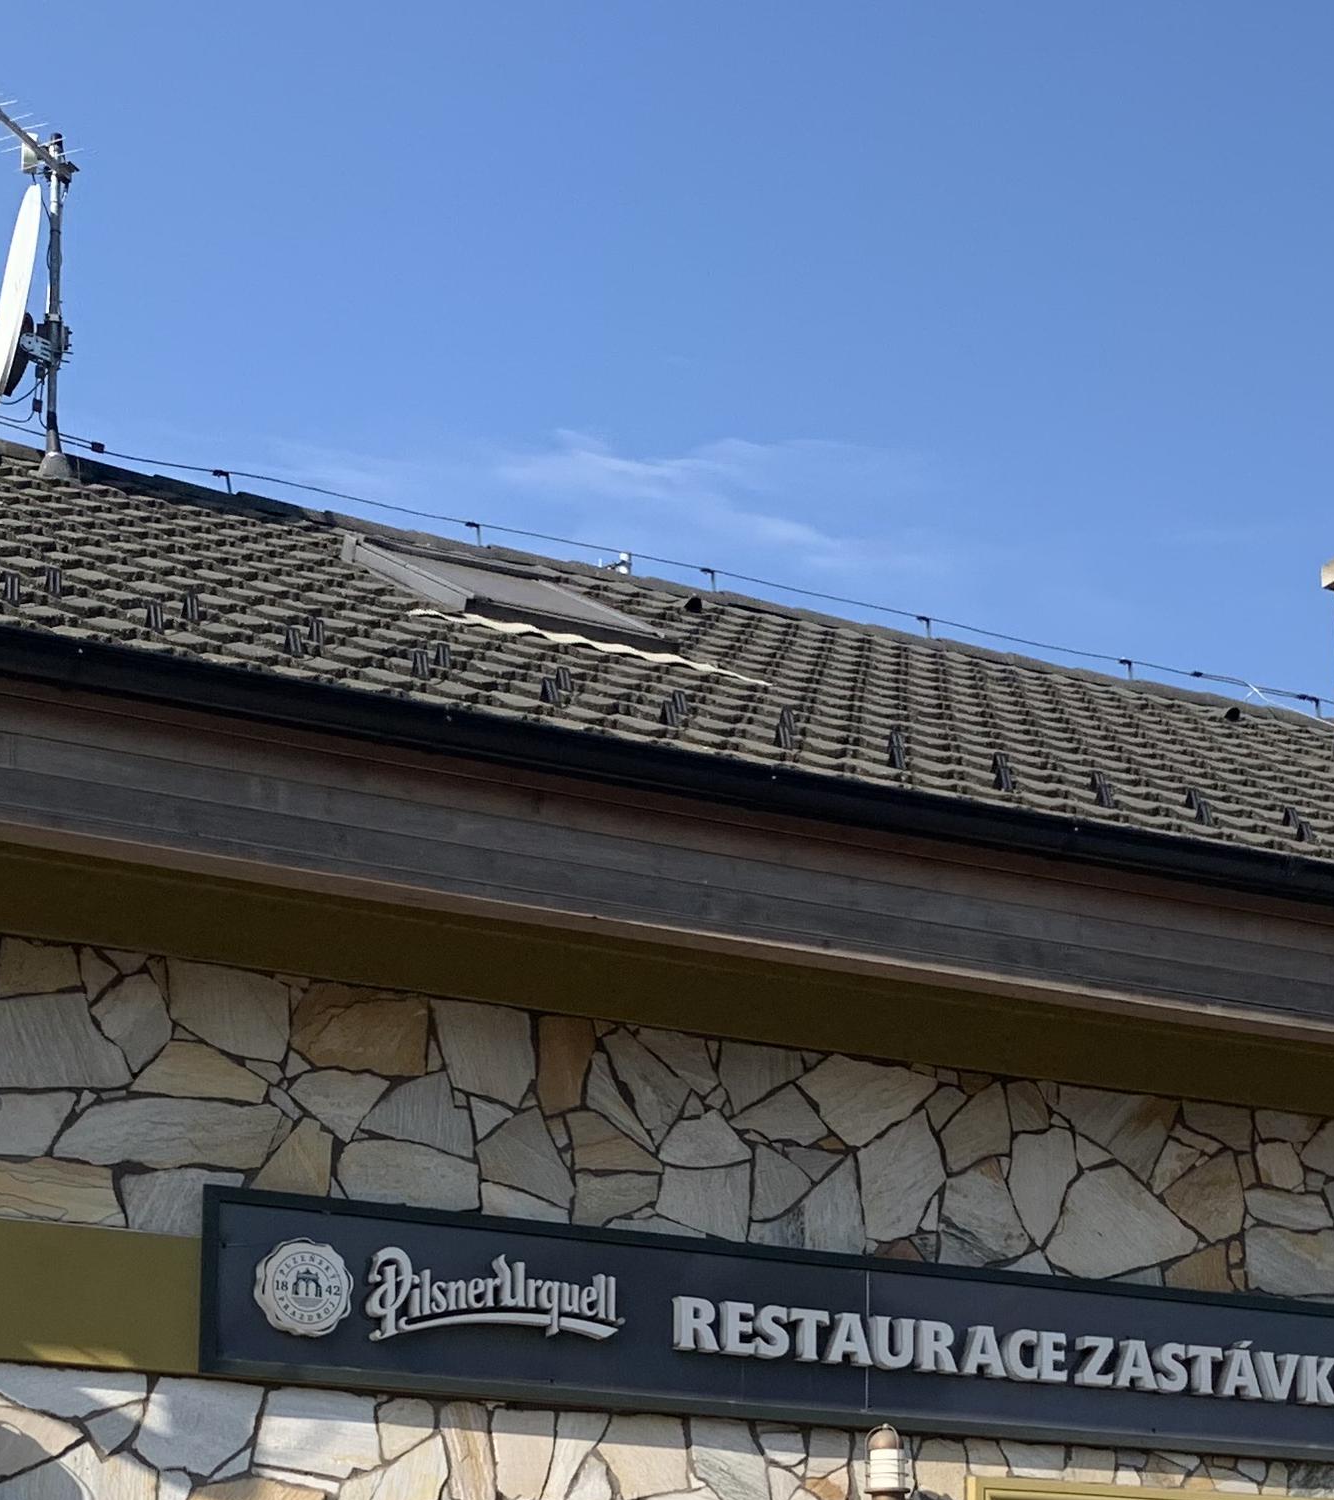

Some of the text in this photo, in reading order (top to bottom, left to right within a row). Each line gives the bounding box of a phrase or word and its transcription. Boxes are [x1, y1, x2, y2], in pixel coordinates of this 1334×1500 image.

[275, 1280, 342, 1297] 18 42
[365, 1246, 617, 1342] Pilsner Urquell
[671, 1295, 1068, 1384] RESTAURACE
